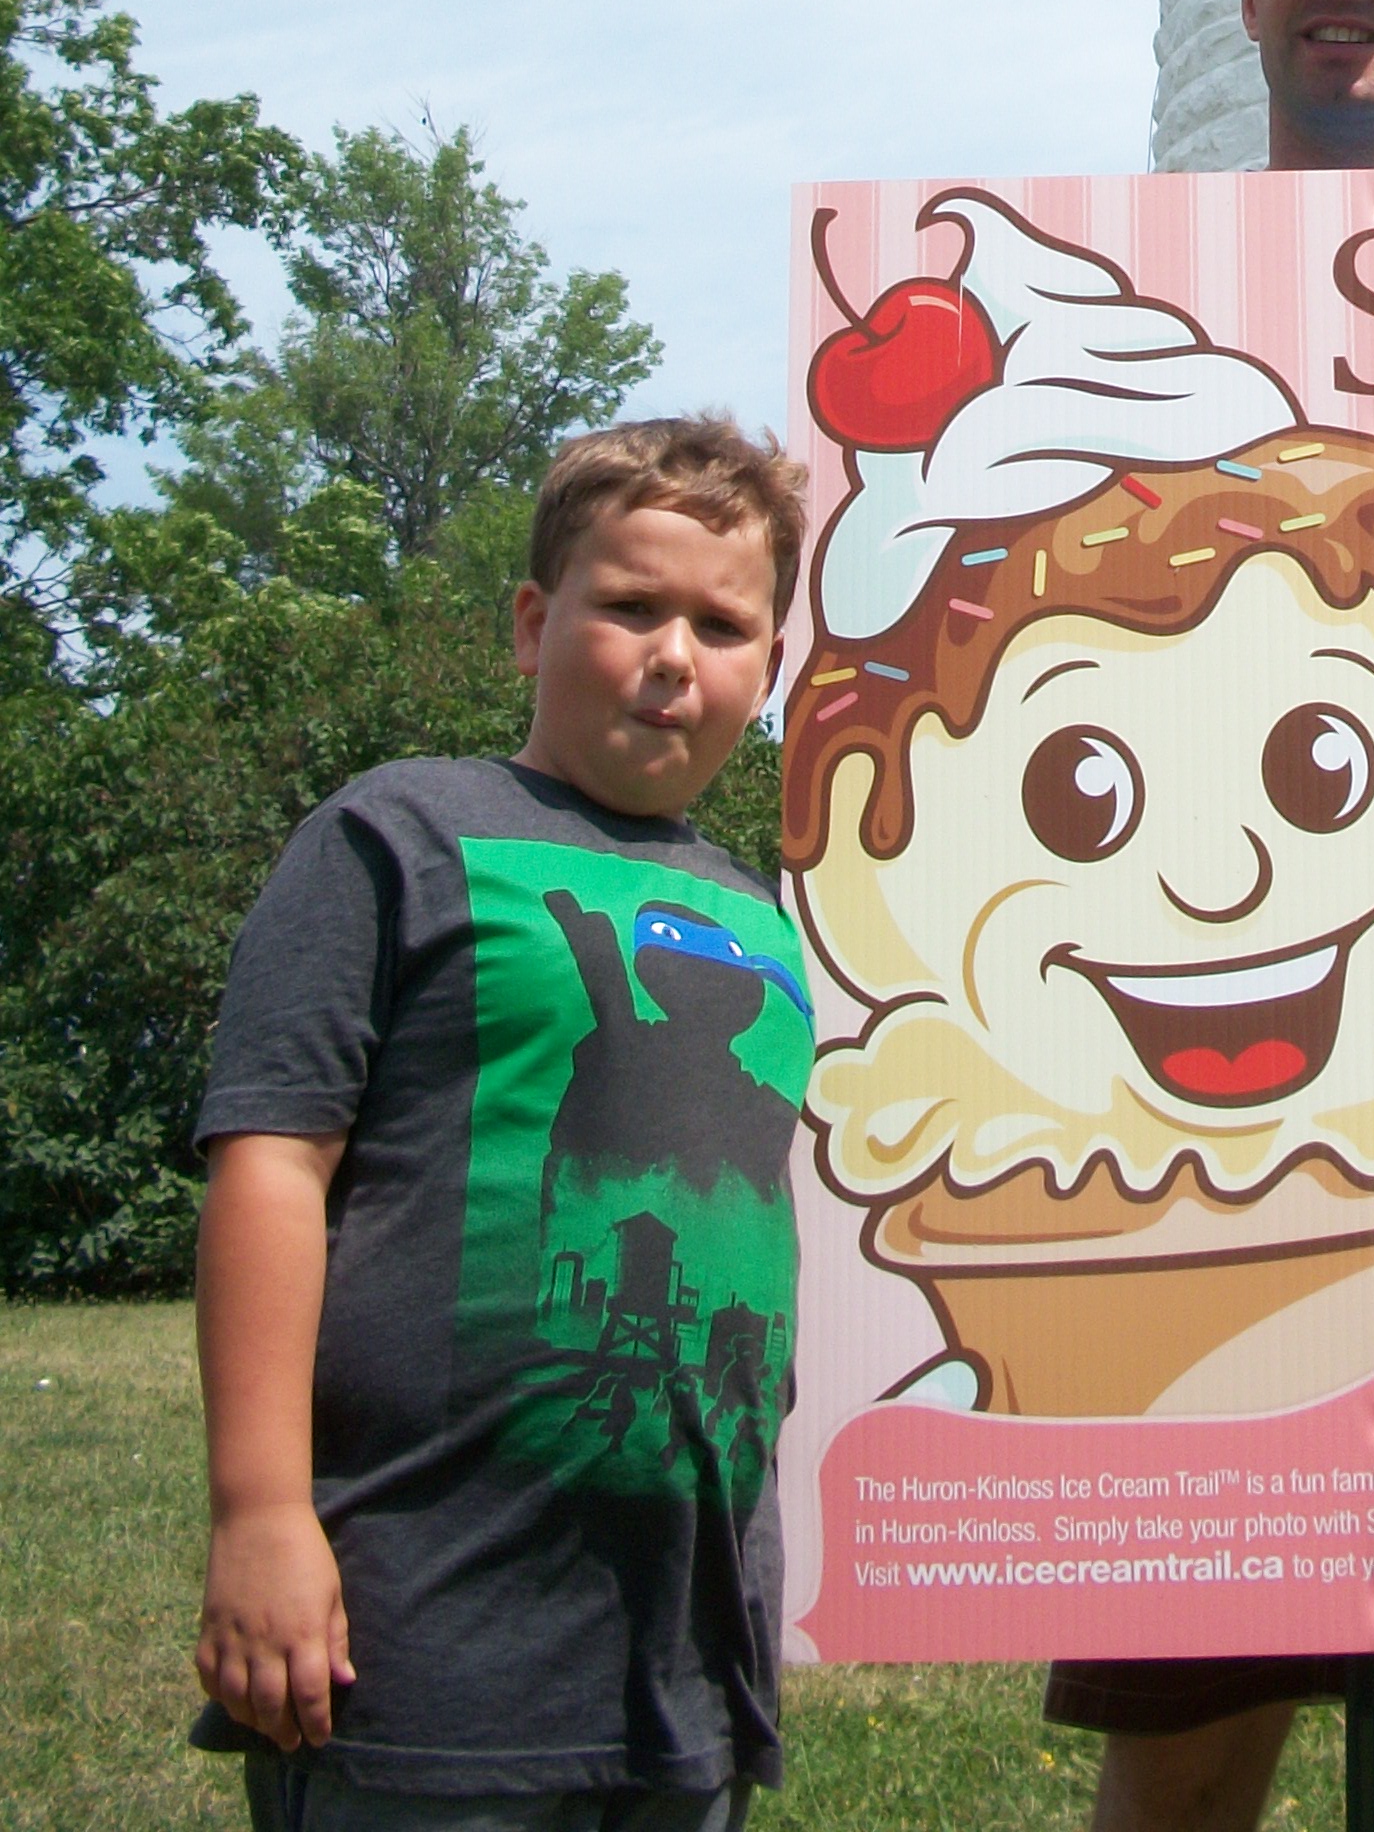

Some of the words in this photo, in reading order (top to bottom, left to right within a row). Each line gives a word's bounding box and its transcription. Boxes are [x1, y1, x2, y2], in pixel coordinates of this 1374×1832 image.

[855, 1476, 895, 1502] The
[902, 1475, 1053, 1501] Huron-Kinloss
[1060, 1475, 1091, 1498] Ice
[1098, 1473, 1169, 1498] Cream
[1247, 1471, 1264, 1494] is
[1271, 1474, 1284, 1494] a
[1290, 1469, 1325, 1493] fun
[856, 1519, 874, 1544] in
[882, 1518, 1041, 1543] Huron-Kinloss.
[1054, 1515, 1129, 1546] Simply
[1135, 1514, 1183, 1539] take
[1190, 1516, 1237, 1544] your
[1244, 1511, 1307, 1542] photo
[1313, 1509, 1360, 1535] with
[854, 1560, 901, 1587] Visit
[906, 1550, 1284, 1586] www.icecreamtrail.ca
[1292, 1553, 1313, 1577] to
[1320, 1553, 1355, 1583] get
